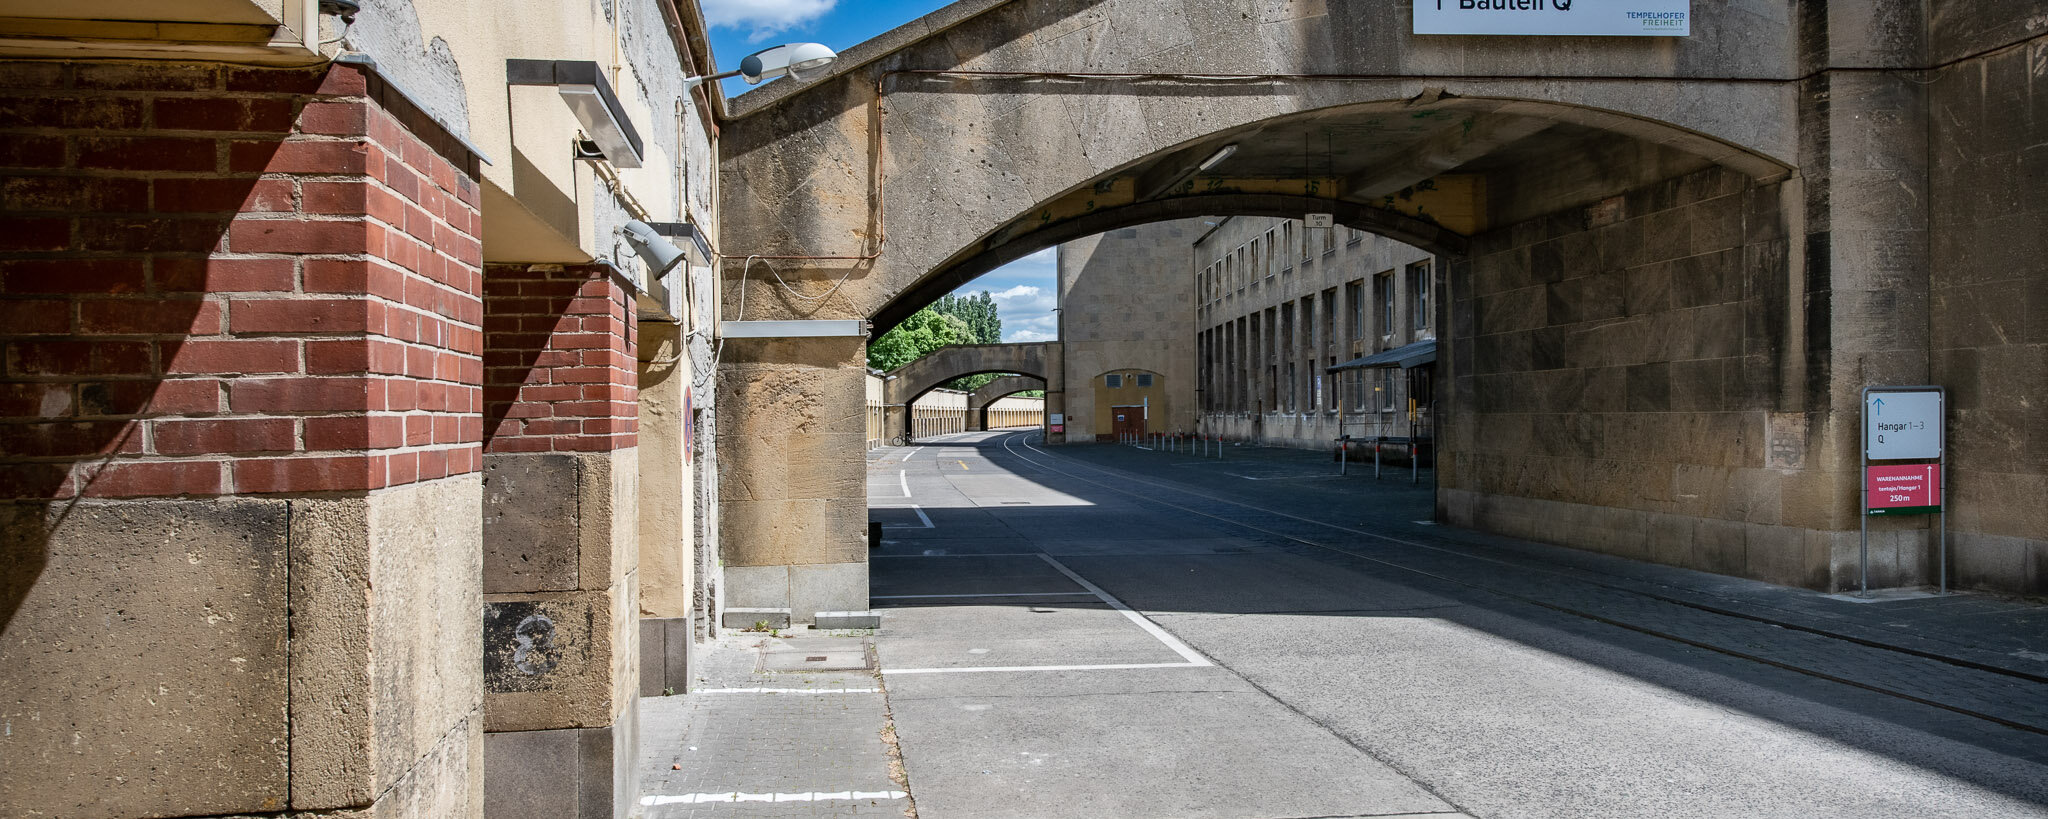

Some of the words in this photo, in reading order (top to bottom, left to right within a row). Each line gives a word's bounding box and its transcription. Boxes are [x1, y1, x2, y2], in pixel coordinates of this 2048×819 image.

[1626, 12, 1685, 20] TEMPELHOFER
[1878, 422, 1907, 432] Hangar
[1878, 435, 1885, 444] Q
